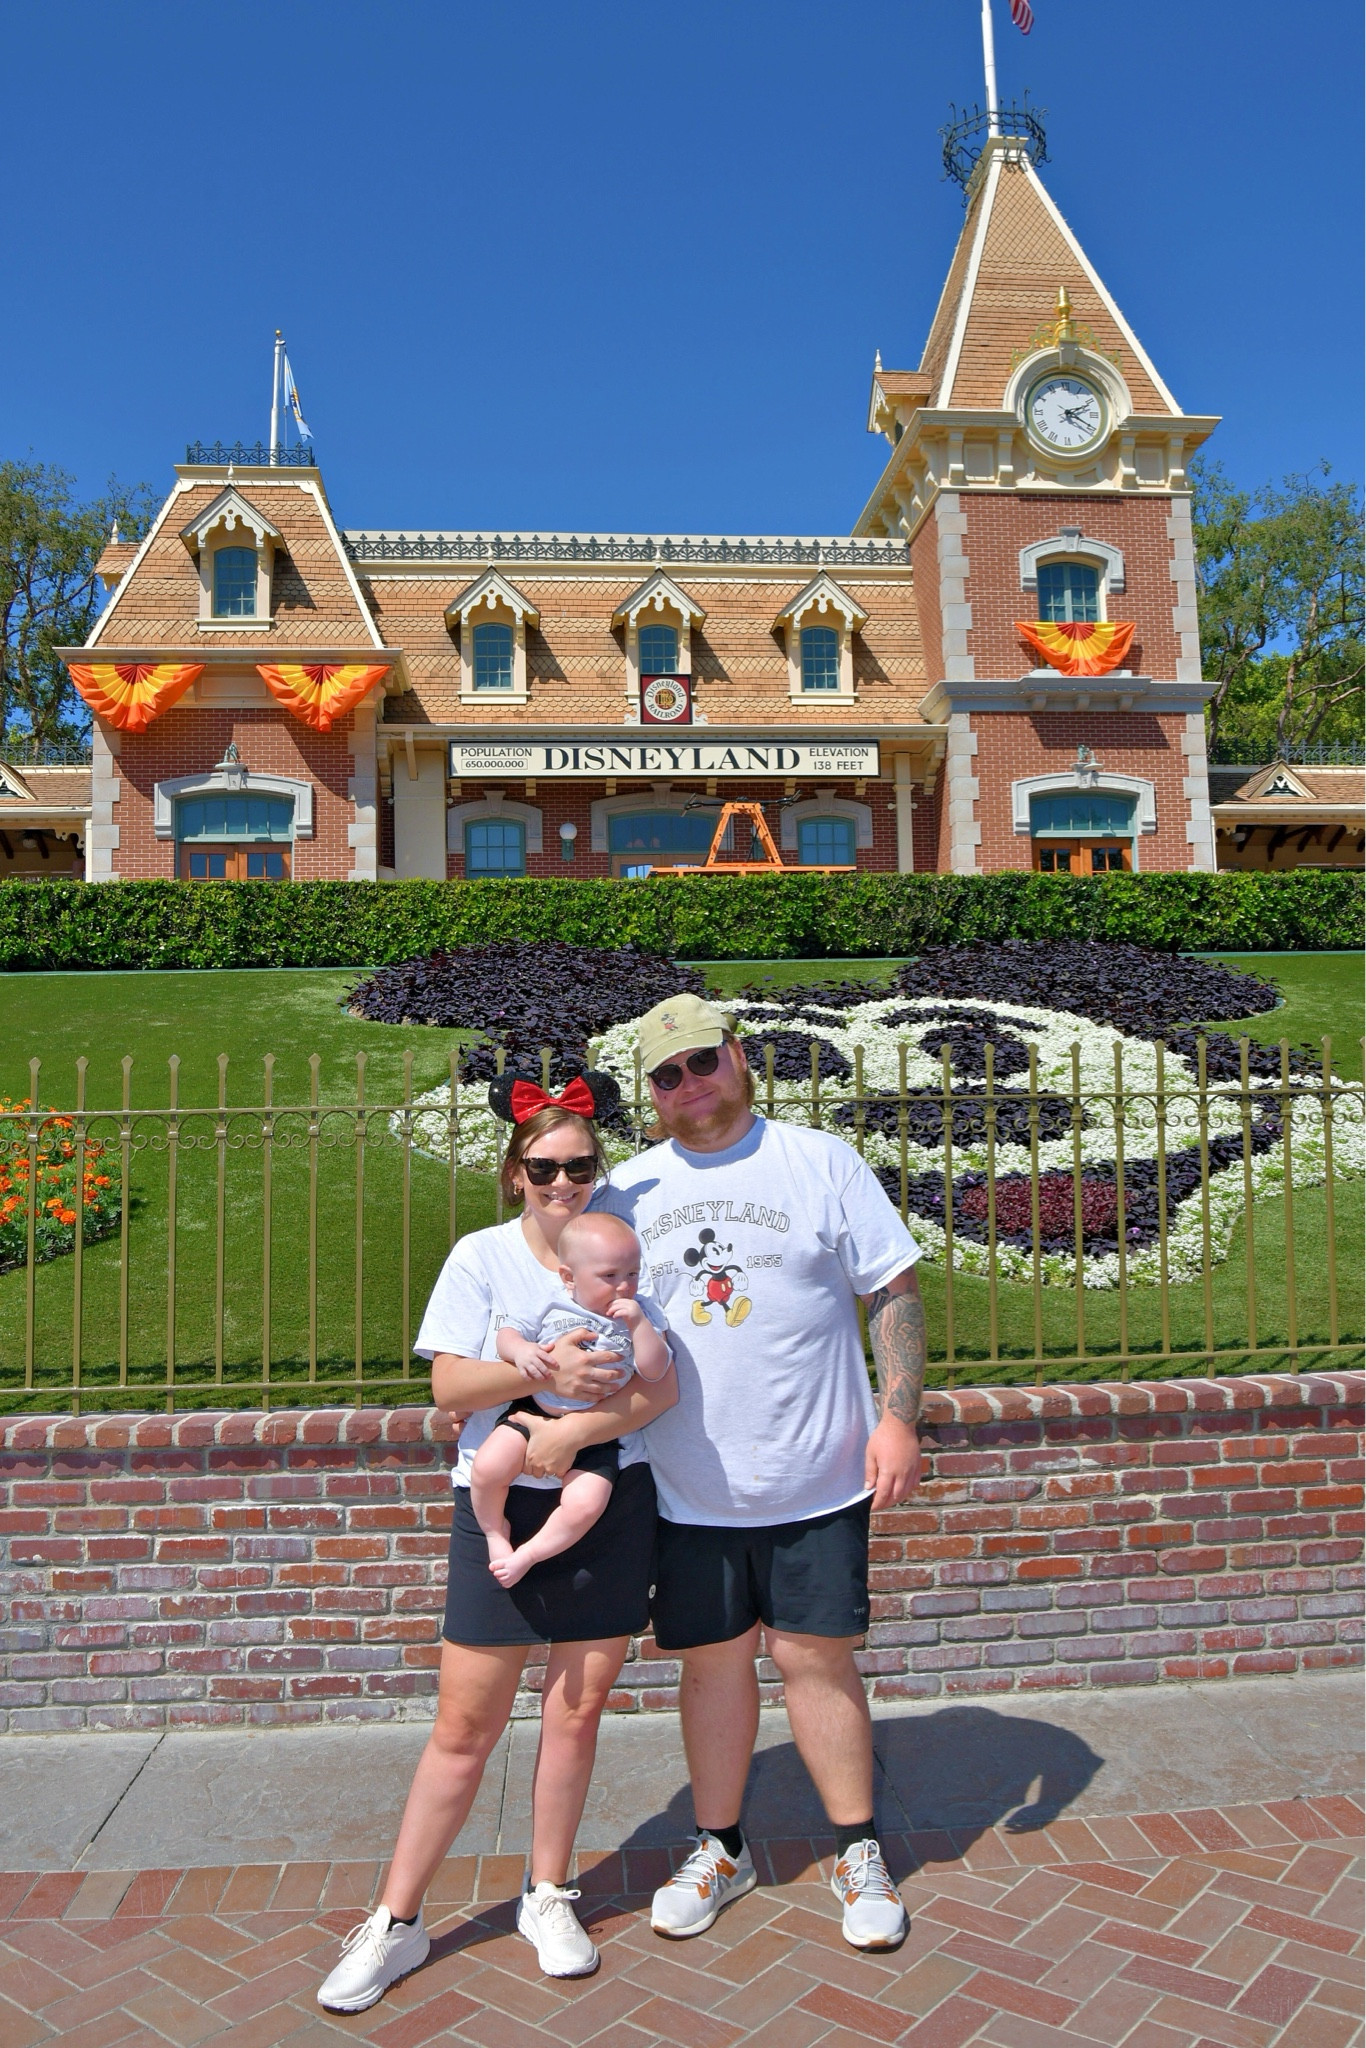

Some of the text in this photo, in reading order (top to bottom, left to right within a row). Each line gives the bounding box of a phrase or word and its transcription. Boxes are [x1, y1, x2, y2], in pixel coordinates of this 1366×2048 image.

[646, 681, 686, 698] Disneyland
[648, 703, 684, 718] RAILROAD
[461, 748, 533, 757] POPULATION
[809, 748, 869, 757] ELEVATION
[542, 747, 801, 770] DISNEYLAND
[465, 760, 525, 769] 650,000,000
[814, 761, 864, 770] 138 FEET
[747, 1254, 783, 1268] 1955
